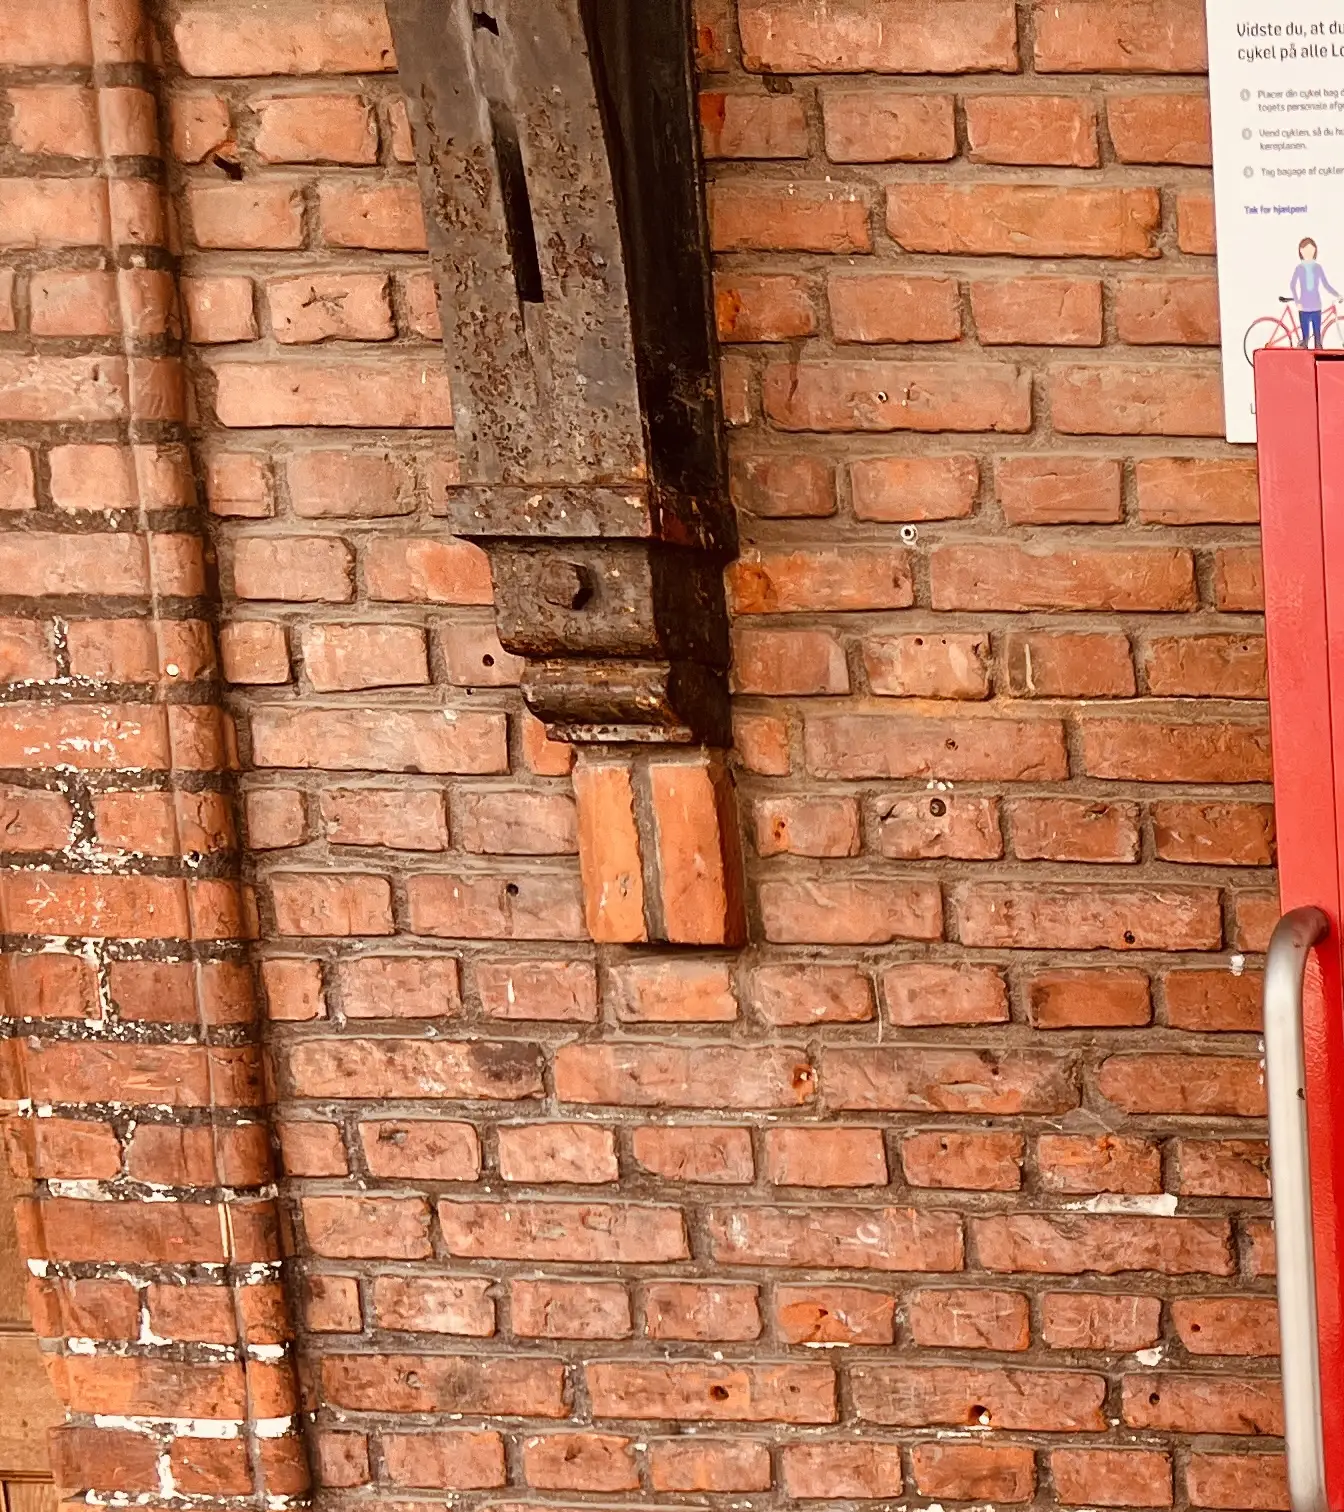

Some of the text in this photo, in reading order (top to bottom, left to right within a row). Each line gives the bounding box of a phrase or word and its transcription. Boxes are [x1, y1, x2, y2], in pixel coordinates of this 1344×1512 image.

[1237, 21, 1282, 37] Vidste
[1285, 21, 1307, 38] du,
[1310, 21, 1325, 35] at
[1237, 45, 1276, 63] cykel
[1280, 42, 1297, 62] på
[1300, 43, 1328, 58] alle
